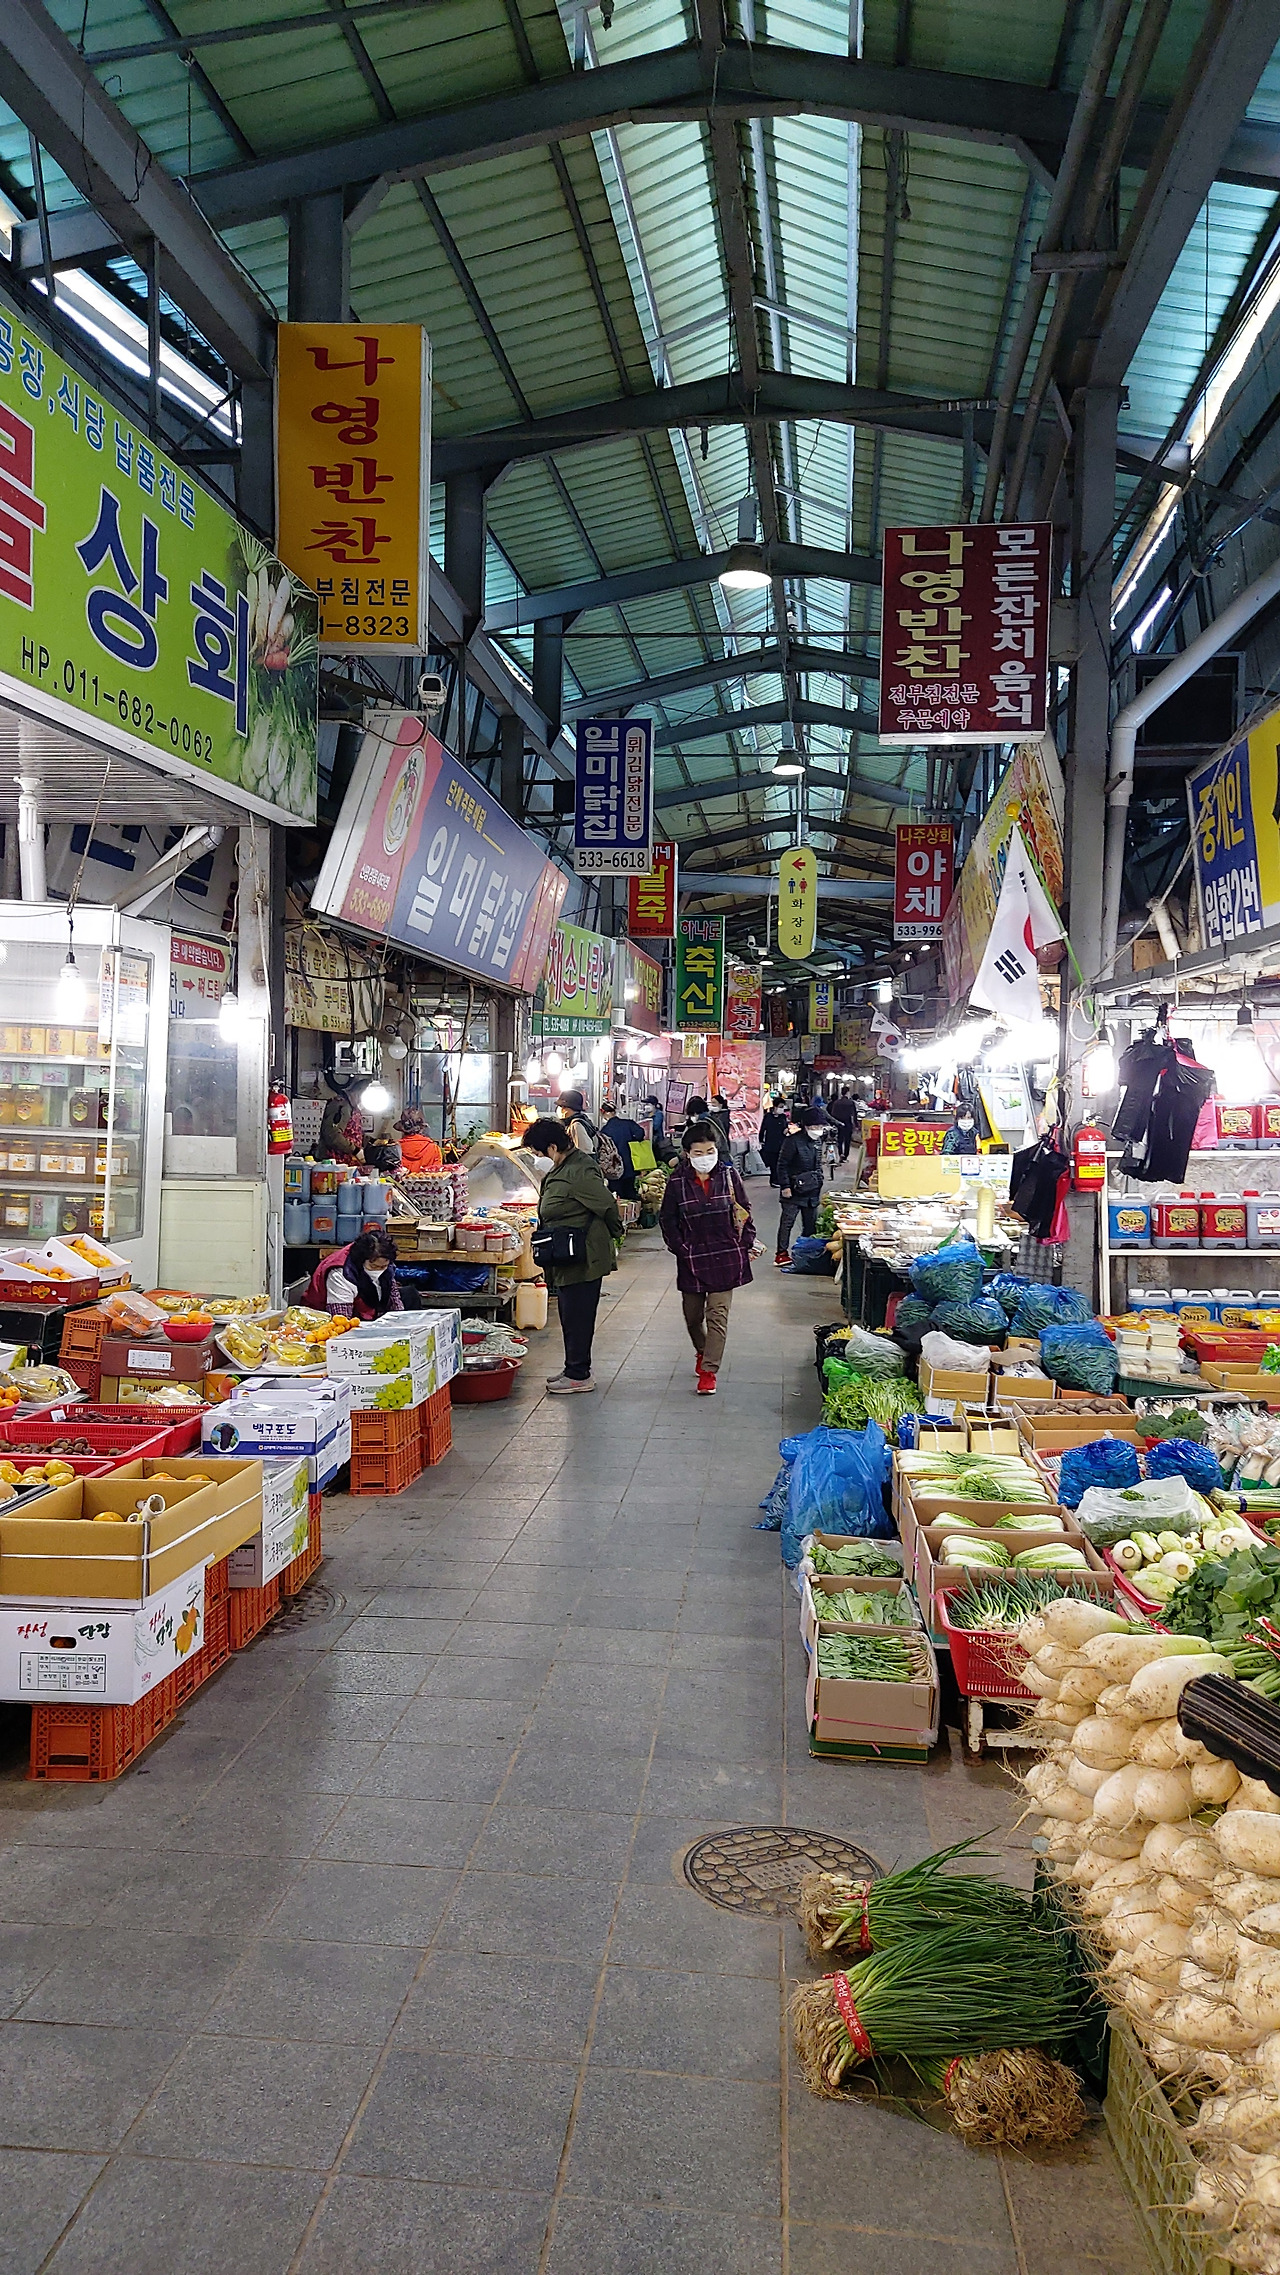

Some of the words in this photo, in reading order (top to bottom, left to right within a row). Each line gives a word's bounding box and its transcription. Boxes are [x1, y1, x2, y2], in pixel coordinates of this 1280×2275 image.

[114, 420, 196, 530] 납품전문
[304, 336, 396, 564] 나영반찬
[75, 482, 250, 738] 상회
[892, 531, 974, 679] 나영반찬
[987, 529, 1041, 725] 모든잔치음식
[20, 633, 214, 765] HP.011-682-0062
[888, 683, 980, 705] 전부침전문
[897, 708, 971, 730] 주문예약
[583, 727, 621, 840] 일미닭집
[578, 851, 645, 868] 533-6618
[900, 828, 952, 845] 나주상회
[406, 826, 528, 968] 일미닭집
[903, 849, 947, 918] 야채
[681, 919, 721, 942] 하나로
[790, 897, 805, 946] 화장실
[897, 925, 943, 936] 533-996
[680, 945, 718, 1015] 축산
[885, 1127, 948, 1155] 도흥팥
[252, 1423, 297, 1435] 백구포도
[17, 1621, 48, 1640] 장성
[77, 1621, 112, 1640] 단감
